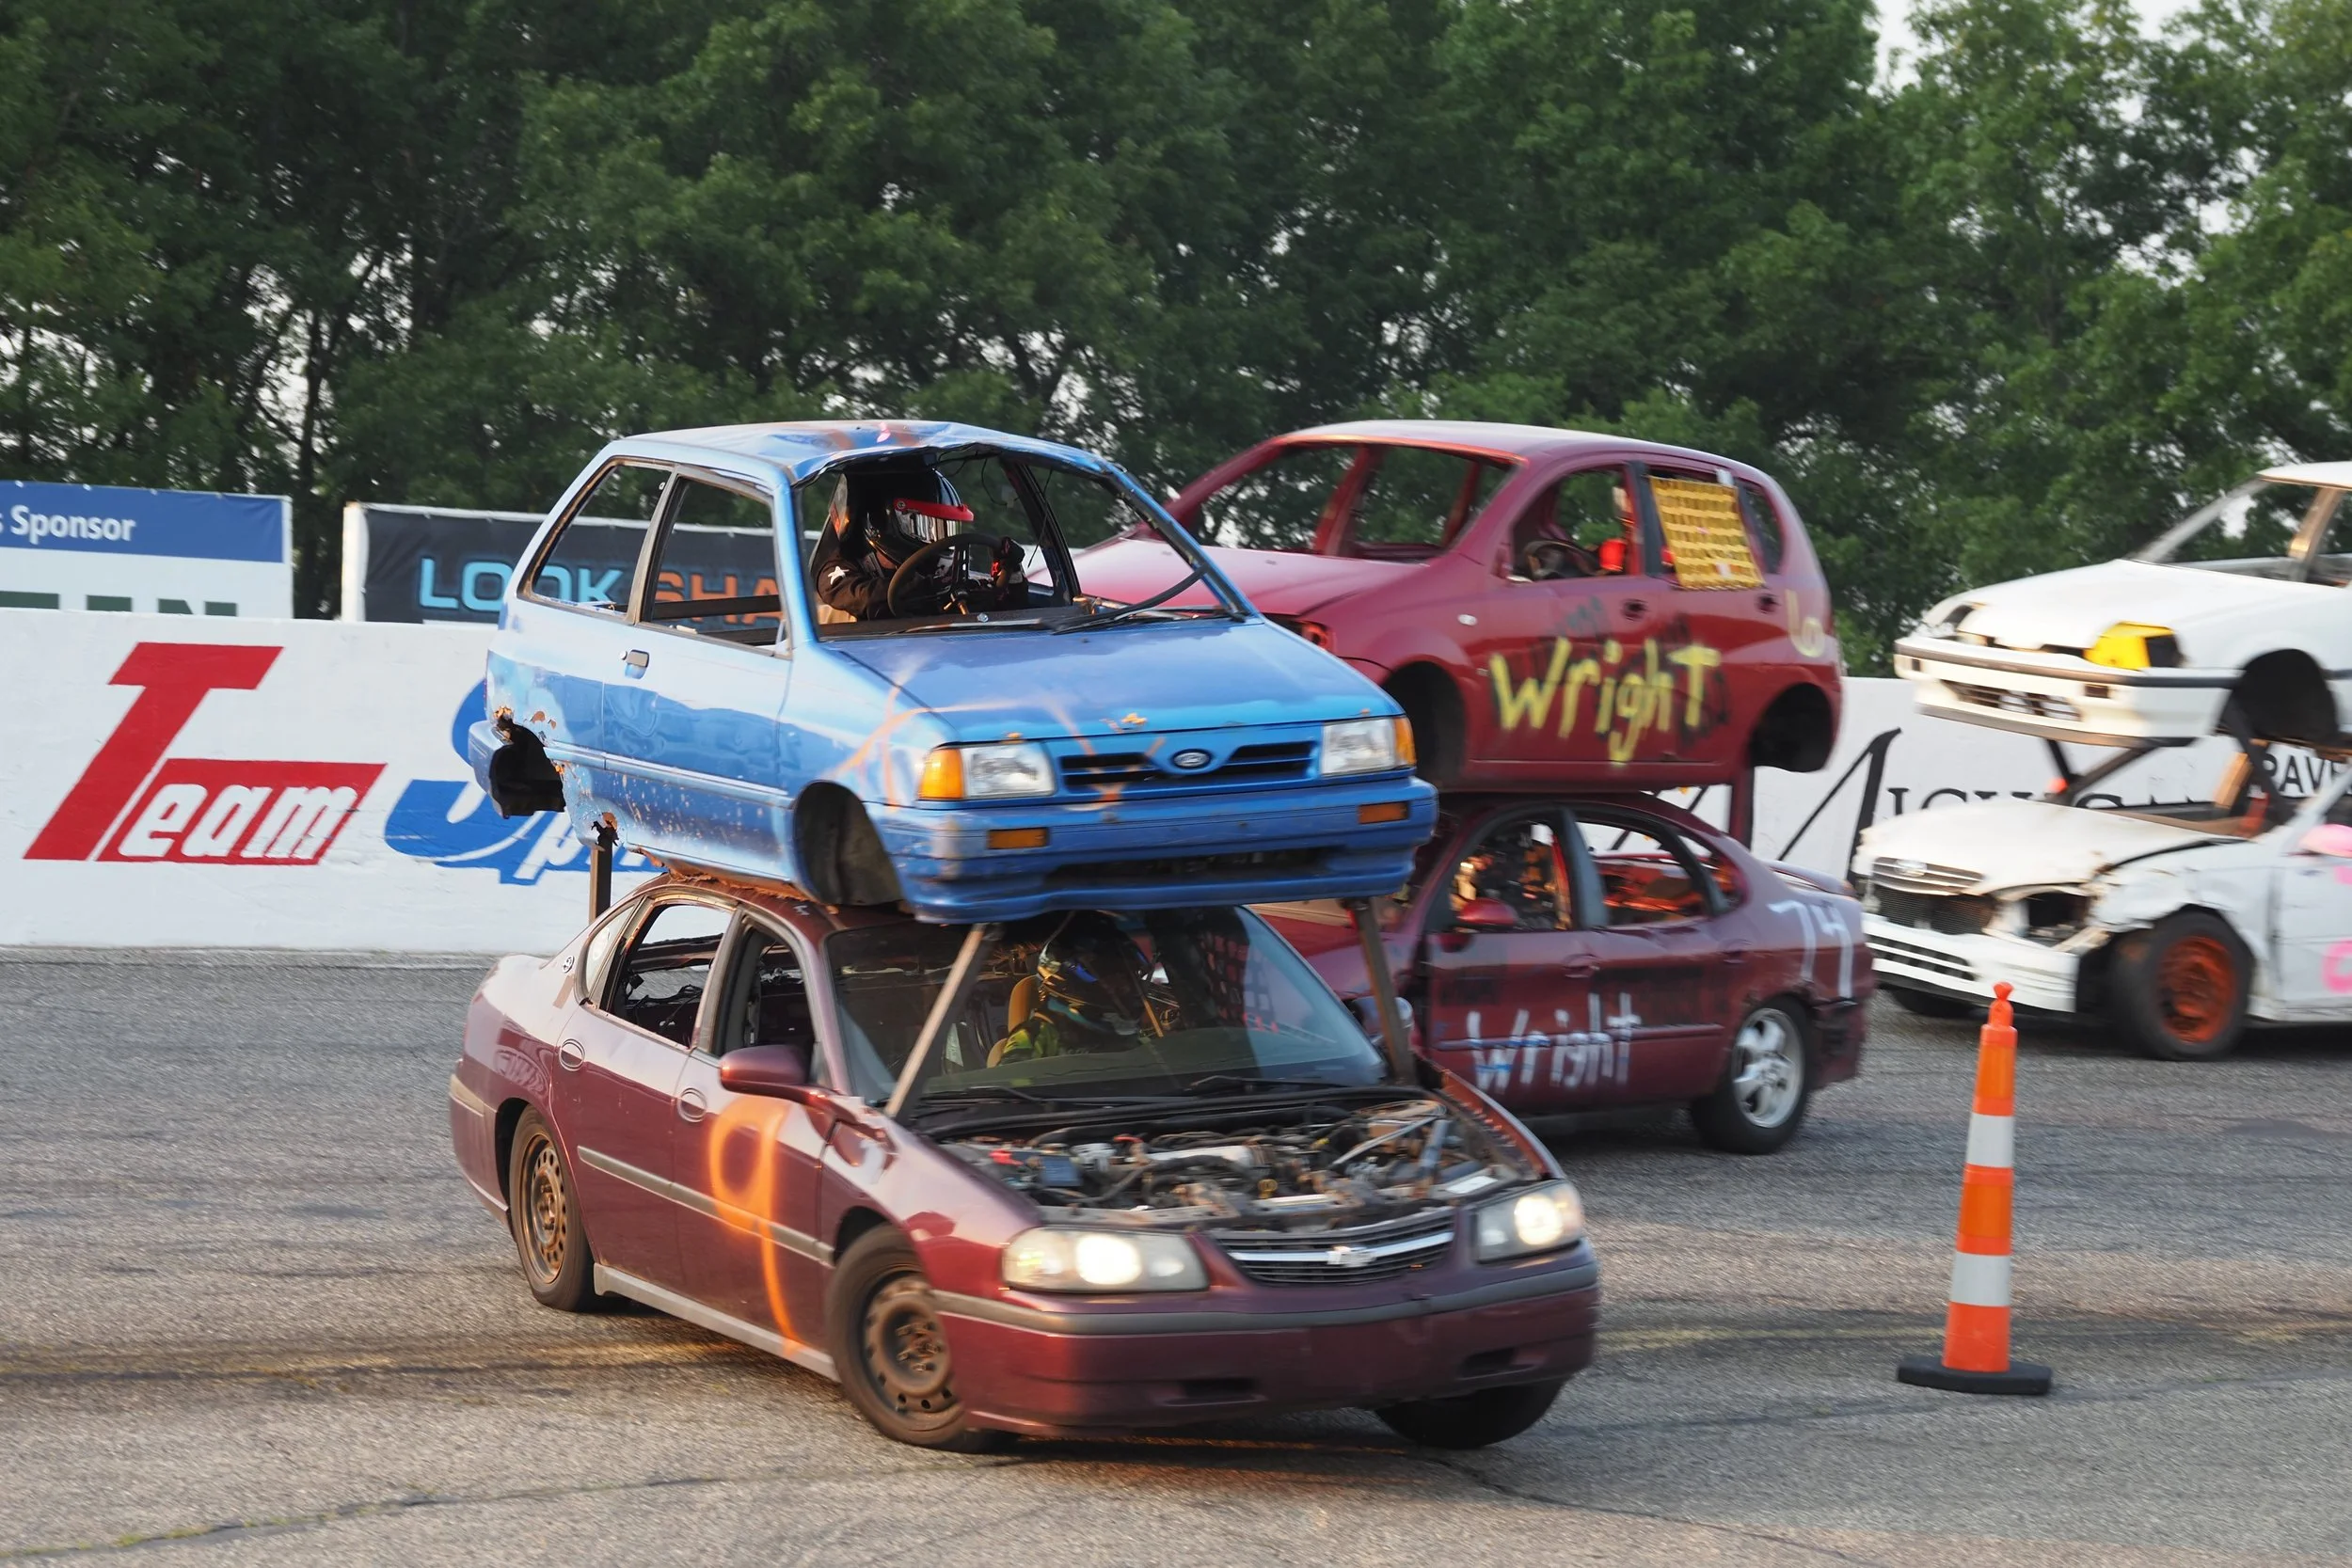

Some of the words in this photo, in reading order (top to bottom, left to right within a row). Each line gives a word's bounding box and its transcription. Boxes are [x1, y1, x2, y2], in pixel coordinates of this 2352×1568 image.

[10, 504, 136, 545] Sponsor
[419, 557, 624, 611] LOOK
[24, 641, 388, 865] Team
[1466, 991, 1644, 1094] Wright
